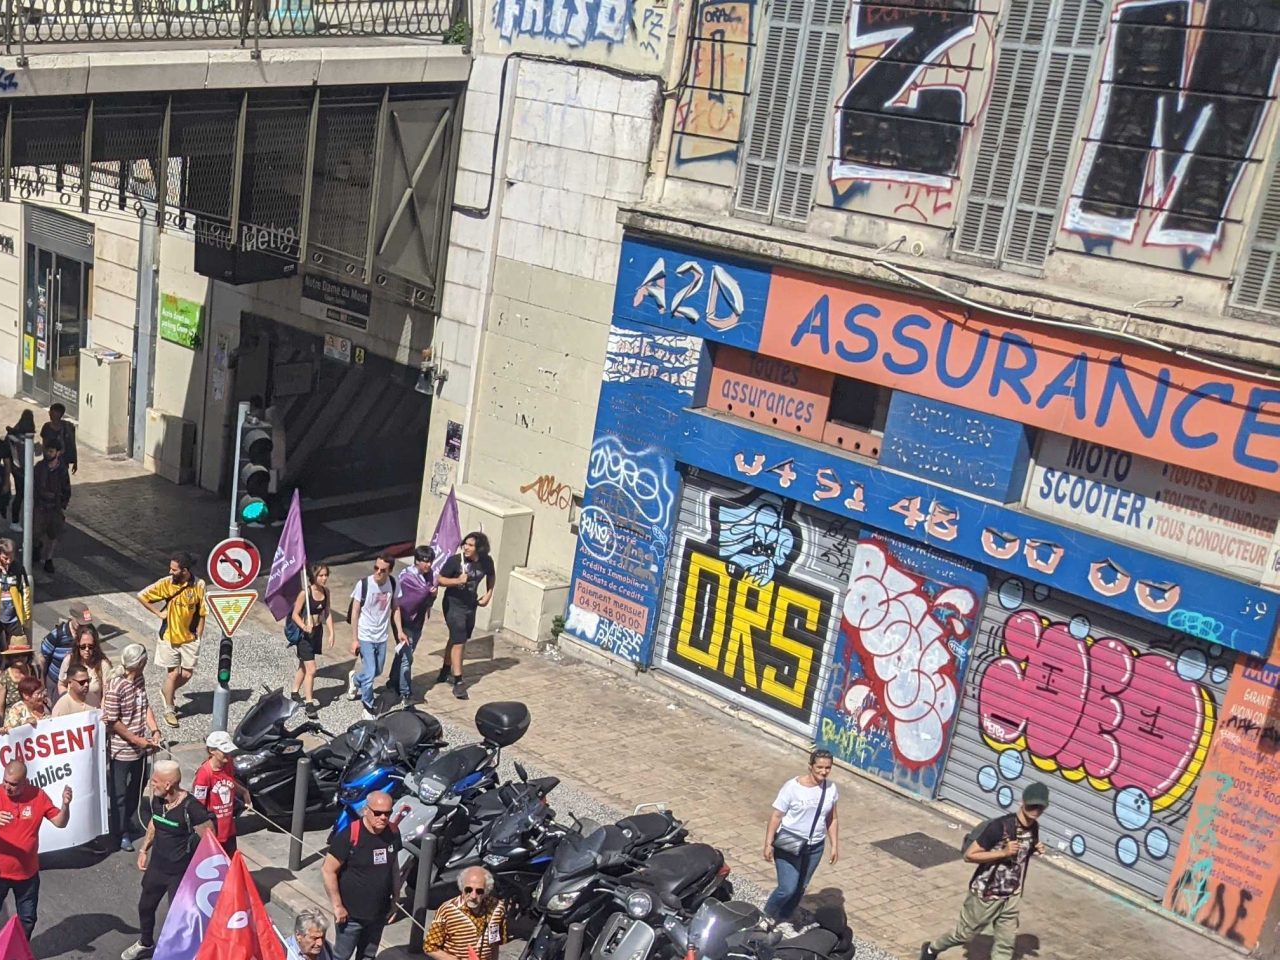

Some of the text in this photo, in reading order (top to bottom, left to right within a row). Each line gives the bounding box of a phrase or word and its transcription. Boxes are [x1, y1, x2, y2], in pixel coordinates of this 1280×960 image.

[241, 221, 295, 252] Métro
[322, 278, 341, 294] Dame
[631, 257, 744, 331] A2D
[721, 378, 815, 425] assurances
[1066, 438, 1133, 482] MOTO
[1039, 467, 1146, 529] SCOOTER
[1154, 514, 1185, 540] TOUS
[582, 558, 607, 575] Crédits
[577, 581, 645, 619] Paiement mensuel
[608, 580, 618, 591] de
[603, 604, 614, 619] 48
[615, 610, 627, 625] 00
[0, 724, 95, 769] CASSENT
[30, 761, 73, 788] ublics
